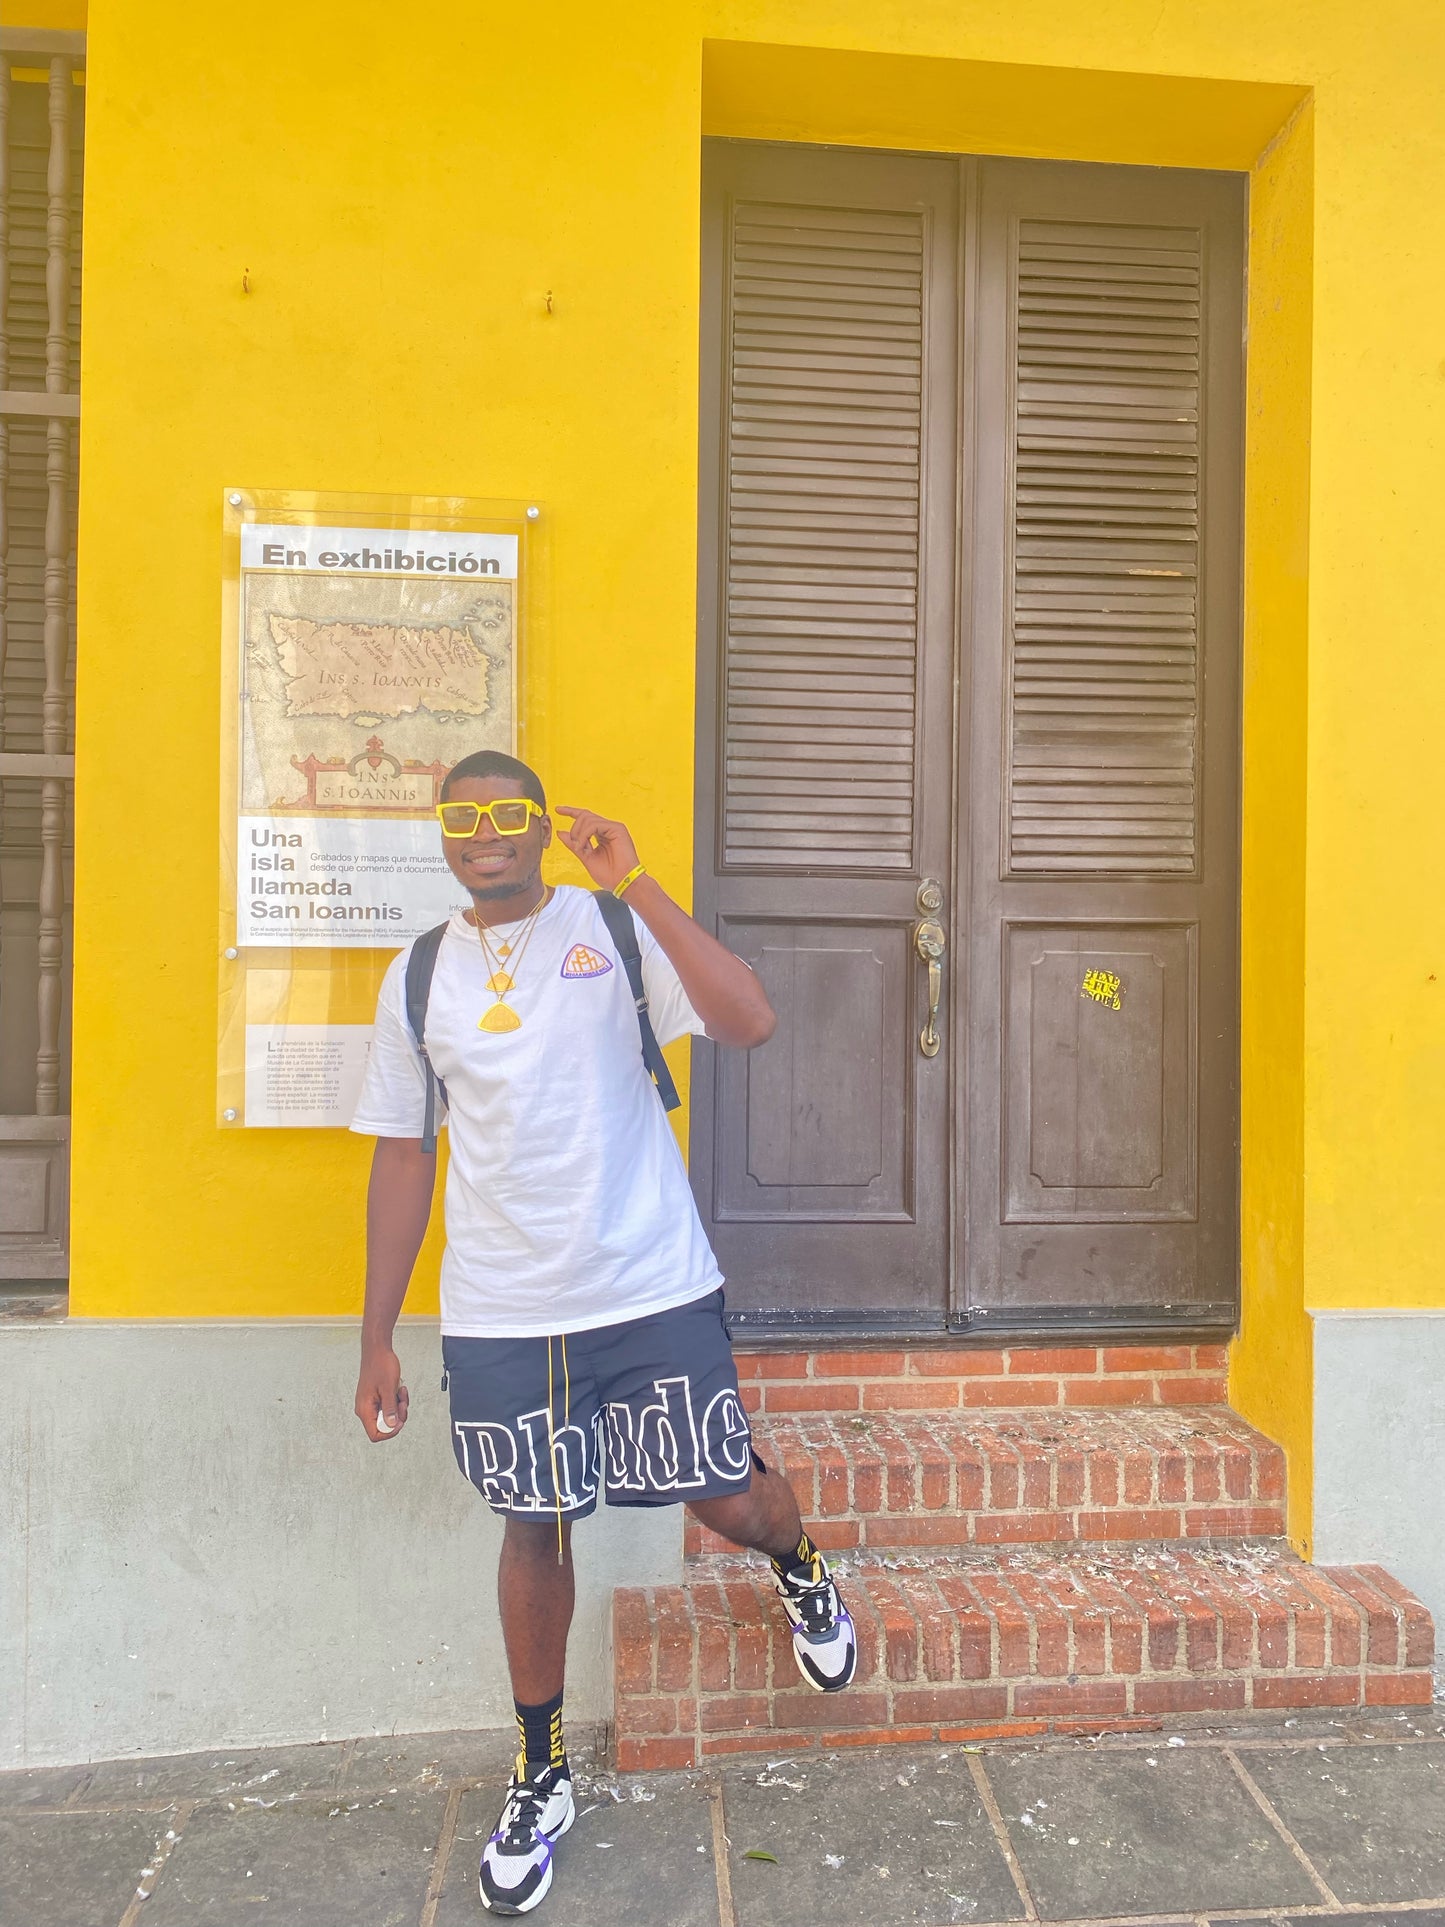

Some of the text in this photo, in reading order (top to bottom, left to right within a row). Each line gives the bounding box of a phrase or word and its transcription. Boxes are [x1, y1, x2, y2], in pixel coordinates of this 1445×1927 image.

[262, 544, 500, 575] En exhibición
[372, 672, 442, 688] IOANNIS
[339, 785, 416, 801] IOANNIS
[251, 829, 303, 848] Una
[251, 853, 295, 872] isla
[310, 853, 352, 862] Grabados
[354, 855, 359, 863] y
[361, 856, 390, 864] mapas
[391, 856, 407, 864] que
[310, 863, 337, 872] desde
[338, 866, 355, 874] que
[356, 864, 395, 873] comenzó
[404, 865, 451, 874] documenta
[251, 877, 352, 896] llamada
[250, 900, 403, 921] San Ioannis
[455, 1375, 750, 1513] Rhude
